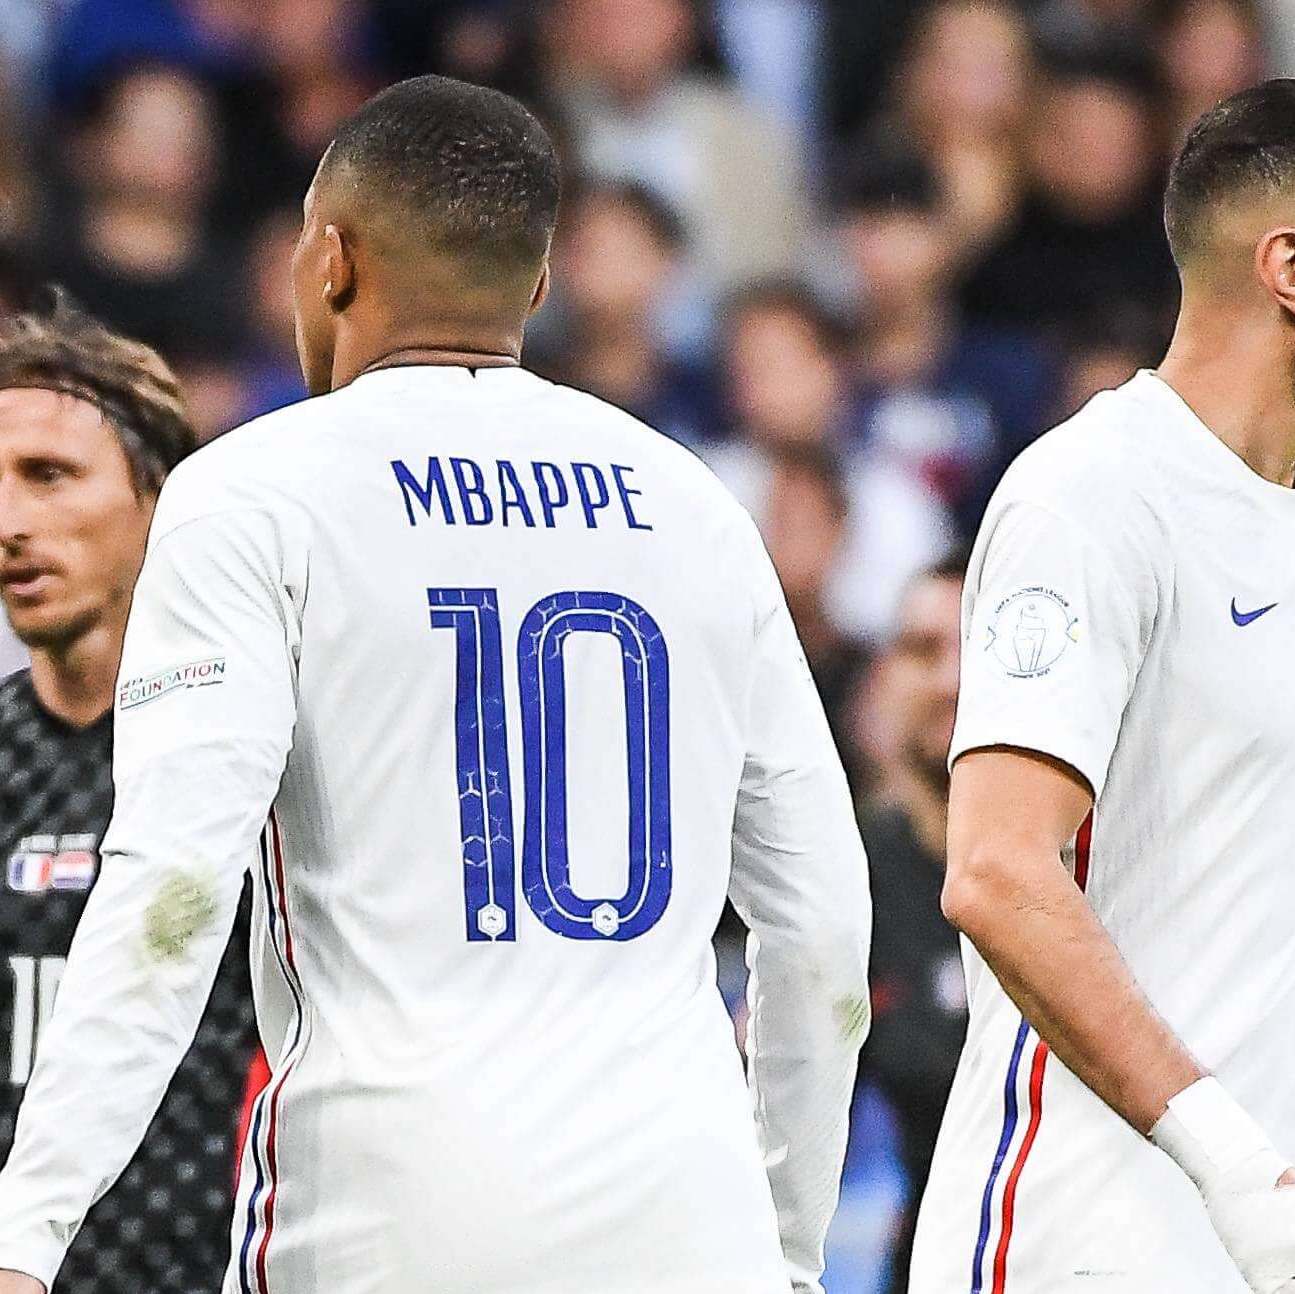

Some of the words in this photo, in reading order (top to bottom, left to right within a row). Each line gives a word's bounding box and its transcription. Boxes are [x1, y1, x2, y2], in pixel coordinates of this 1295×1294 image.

[390, 456, 654, 532] MBAPPE
[119, 661, 226, 706] FOUNDATION
[426, 587, 673, 943] 10
